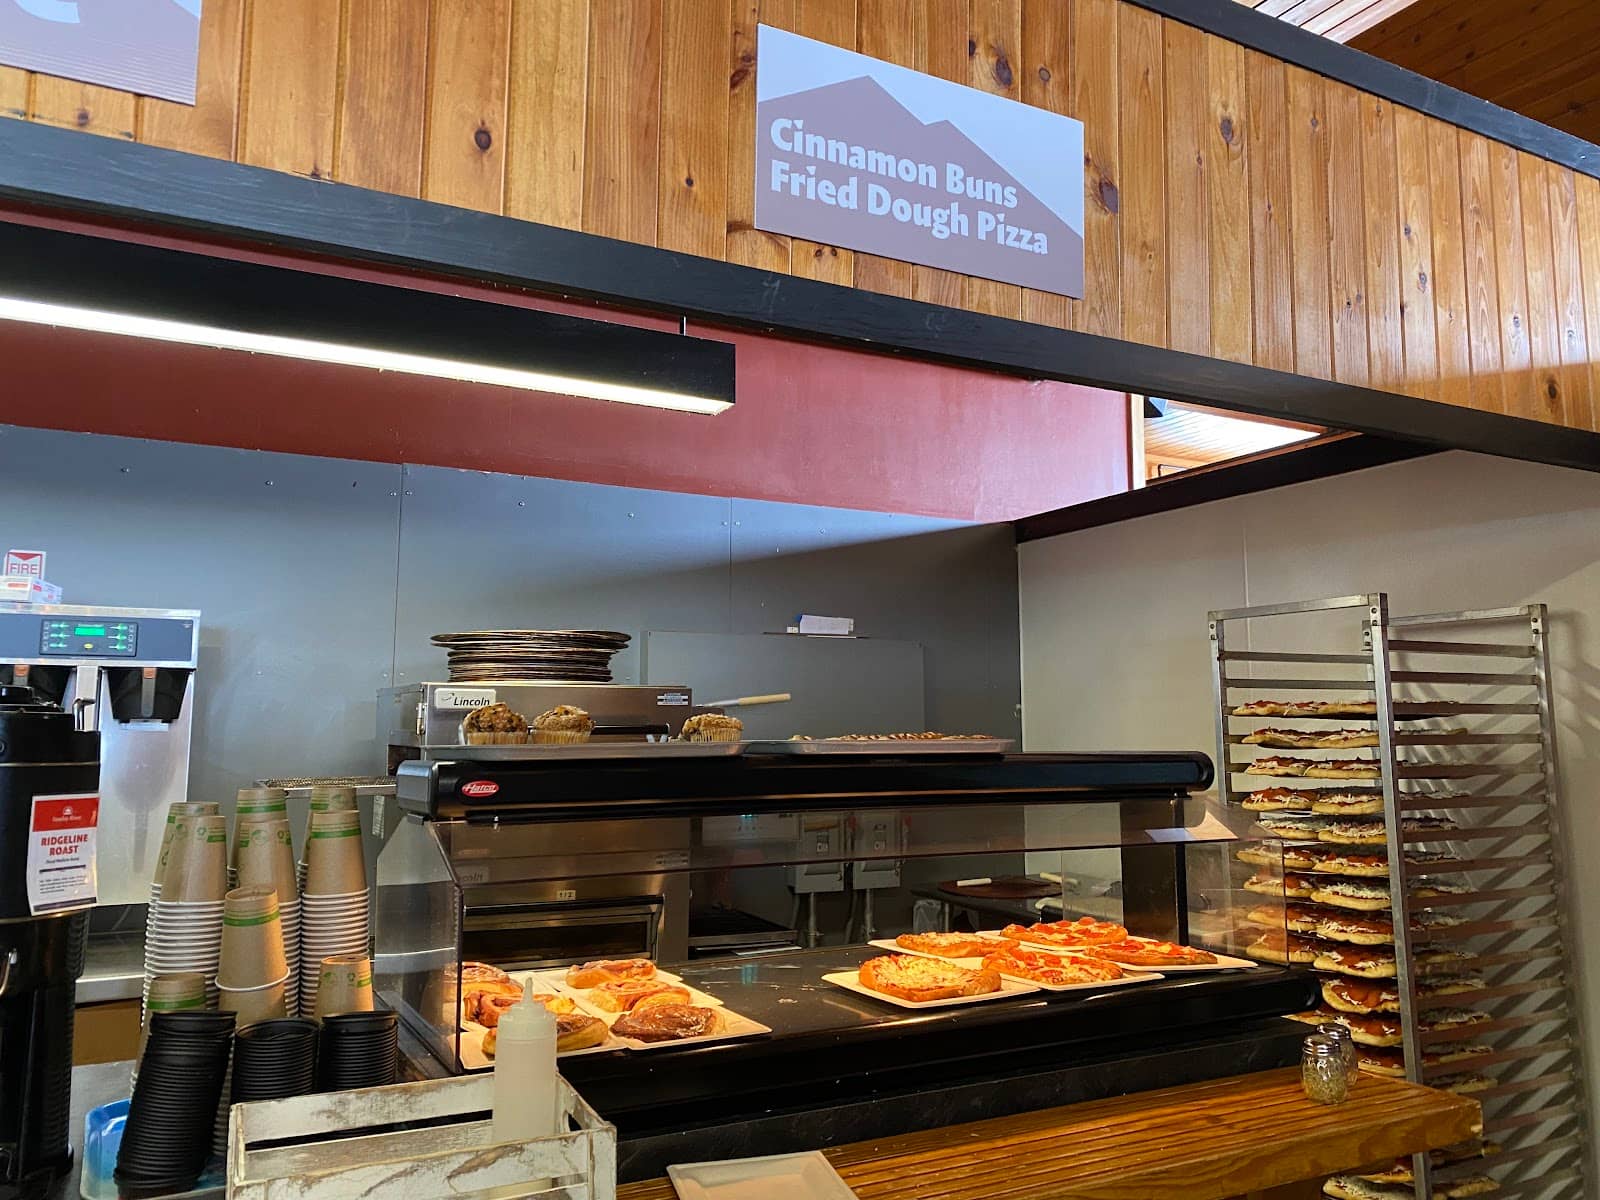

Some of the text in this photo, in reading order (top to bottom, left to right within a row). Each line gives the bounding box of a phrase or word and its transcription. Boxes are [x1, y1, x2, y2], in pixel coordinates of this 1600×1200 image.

[770, 117, 1018, 209] Cinnamon Buns
[770, 159, 1049, 255] Fried Dough Pizza
[10, 563, 39, 574] FIRE
[453, 696, 490, 706] Lincoln
[41, 834, 88, 846] RIDGELINE
[49, 845, 79, 856] ROAST
